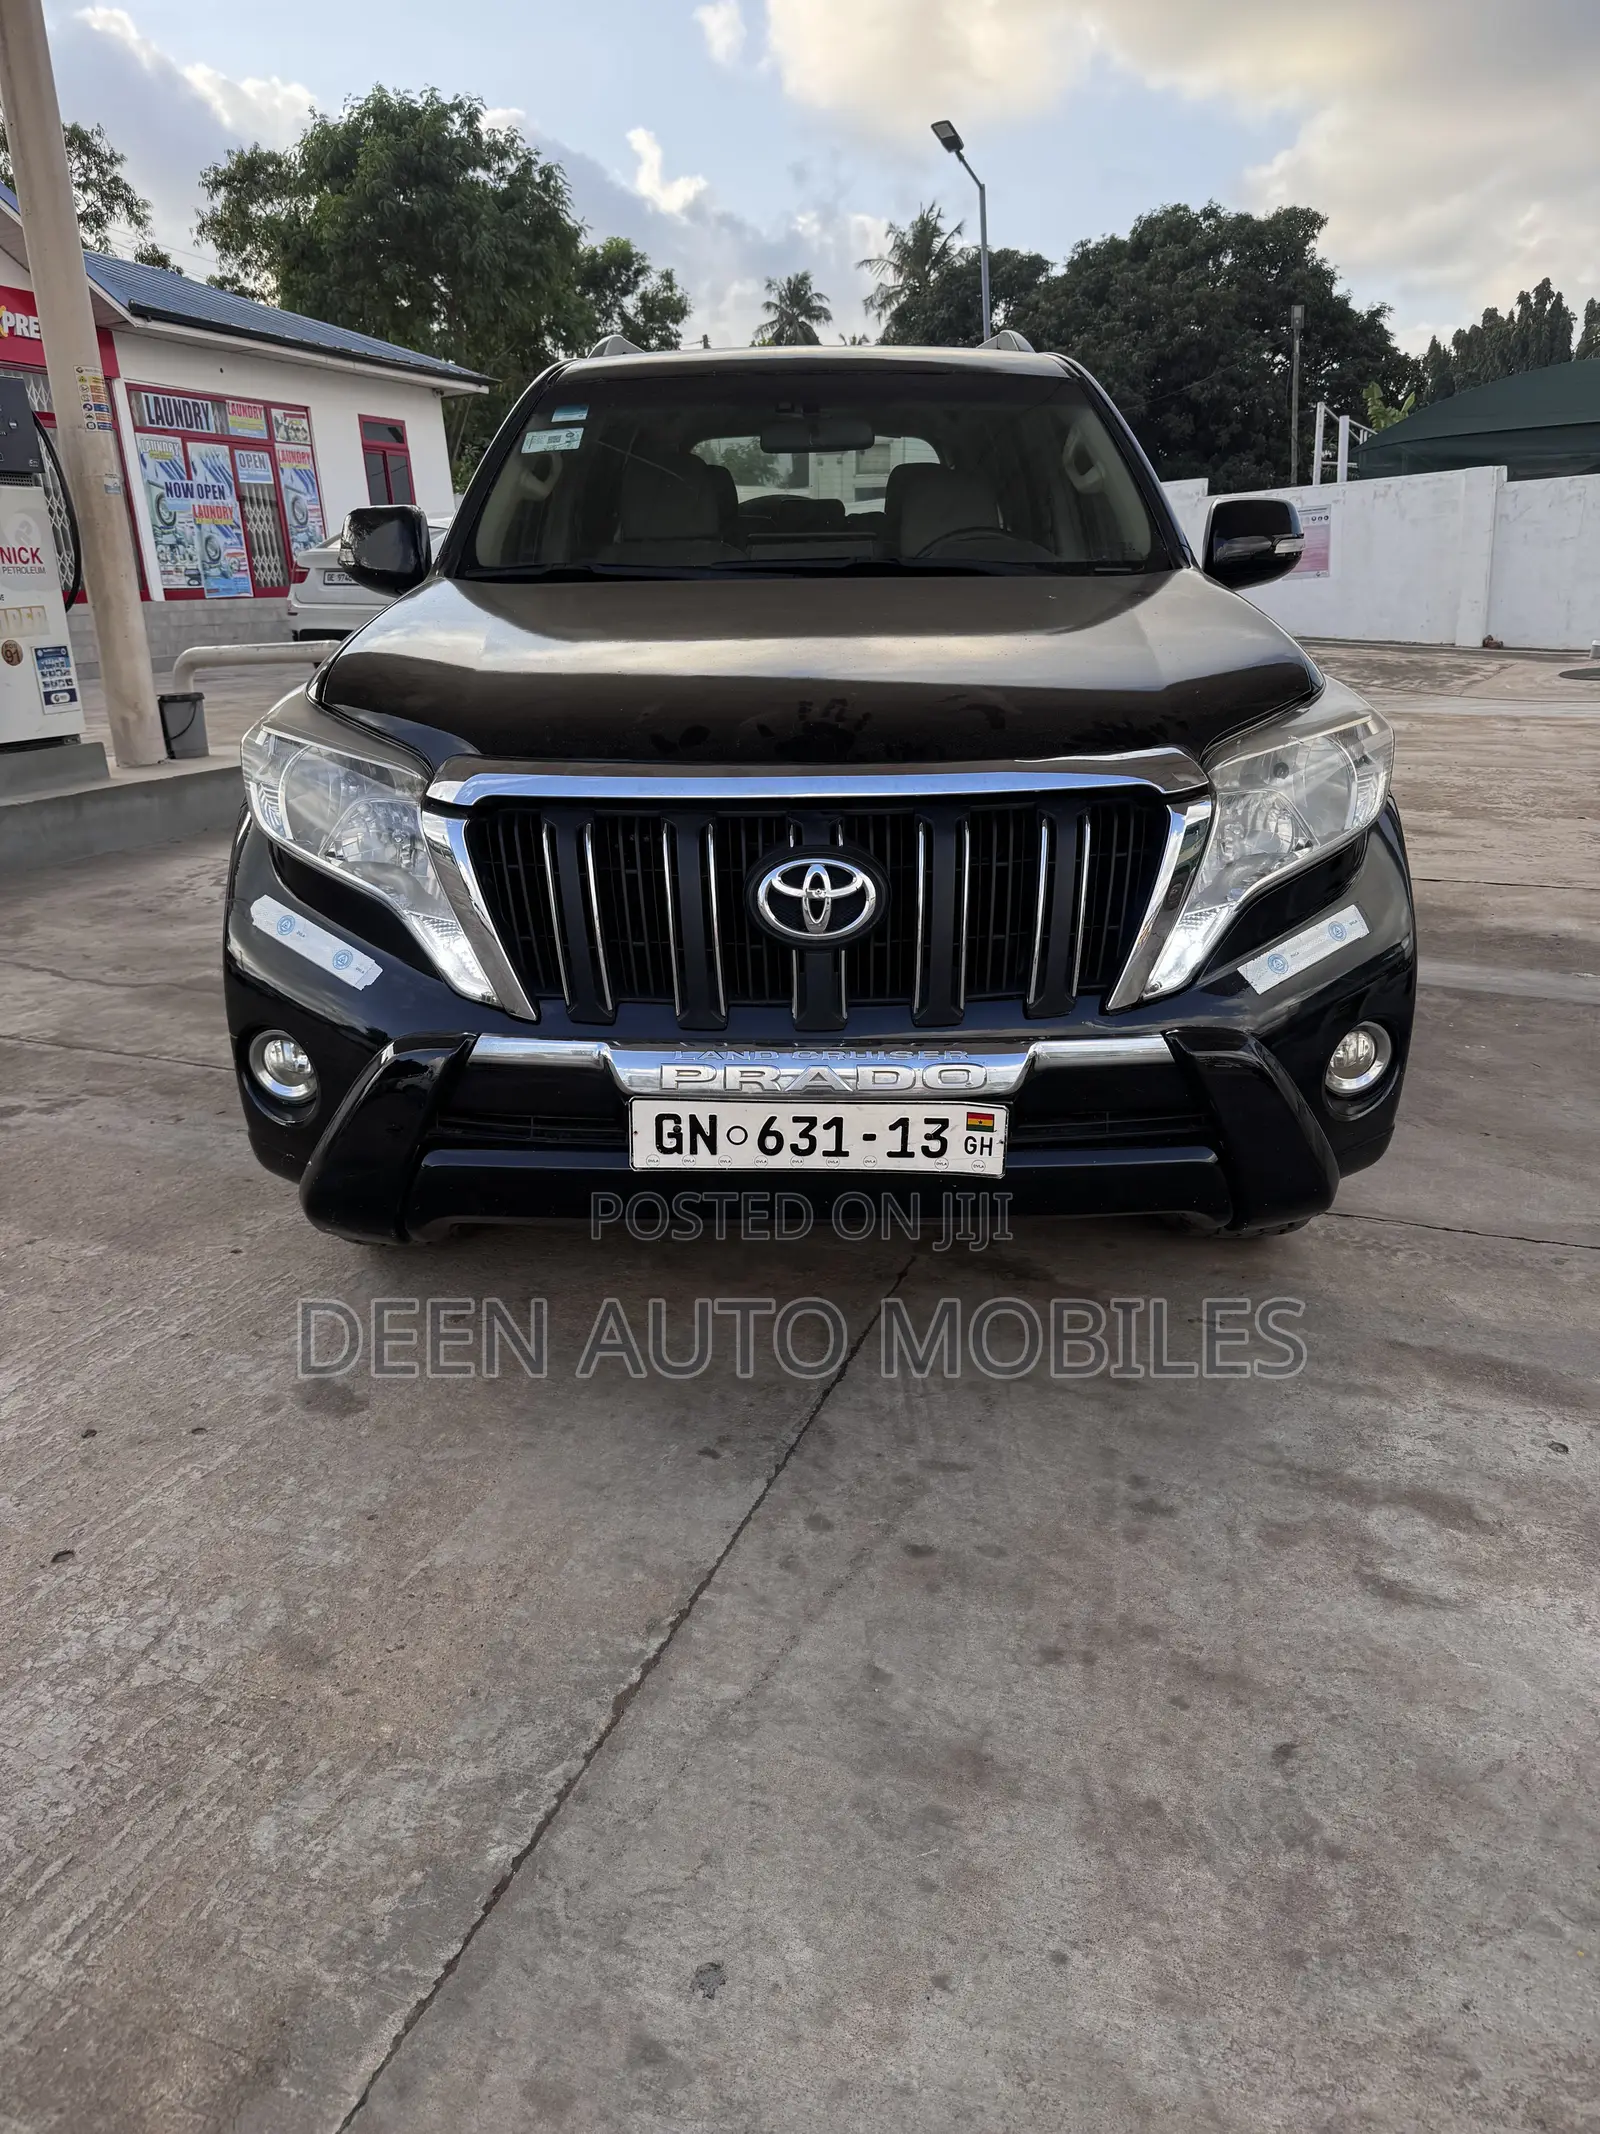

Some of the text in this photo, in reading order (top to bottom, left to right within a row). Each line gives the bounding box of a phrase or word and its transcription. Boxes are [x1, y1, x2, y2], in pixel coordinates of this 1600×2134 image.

[144, 395, 211, 431] LAUNDRY
[228, 402, 263, 420] LAUNDRY
[140, 438, 180, 457] LAUNDRY
[238, 453, 267, 470] OPEN
[278, 449, 311, 464] LAUNDRY
[165, 481, 226, 500] NOW OPEN
[192, 504, 233, 520] LAUNDRY
[3, 566, 46, 574] PETROLEUM
[5, 649, 20, 663] 91
[674, 1050, 970, 1061] LAND CRUISER
[659, 1062, 988, 1092] PRADO
[653, 1112, 718, 1156] GN
[963, 1135, 994, 1157] GH
